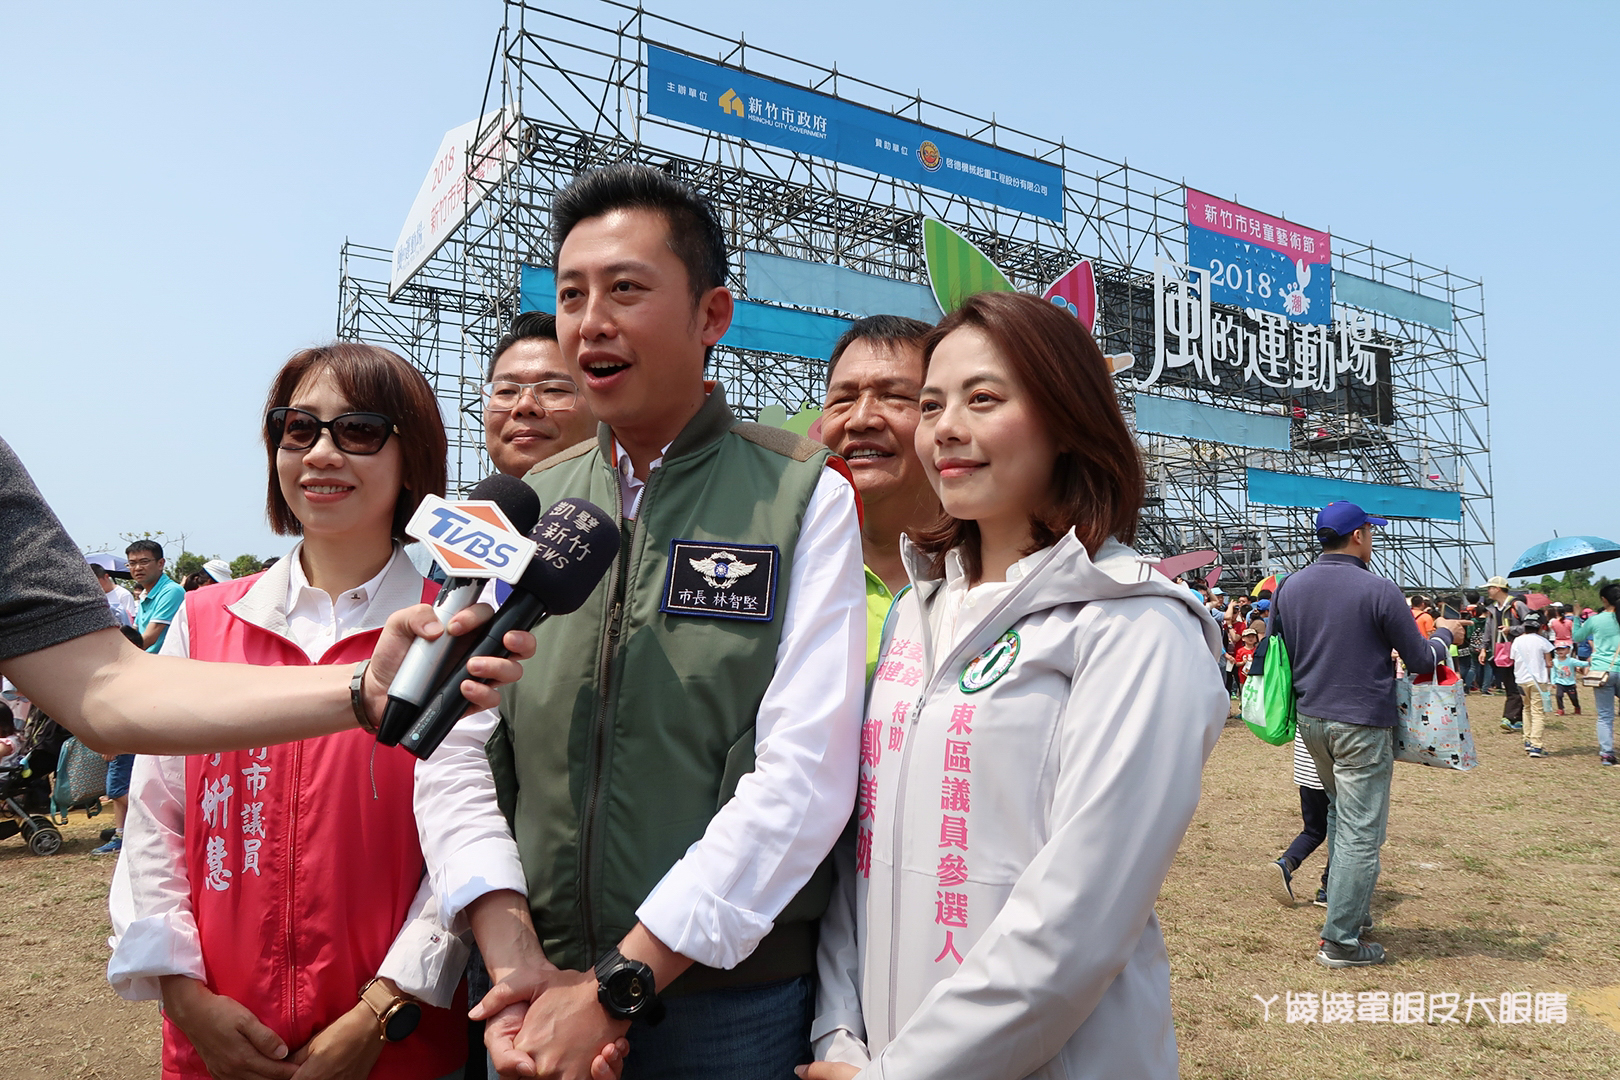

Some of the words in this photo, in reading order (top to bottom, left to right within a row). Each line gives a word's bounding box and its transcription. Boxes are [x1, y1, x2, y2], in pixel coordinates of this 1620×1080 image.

[666, 81, 708, 102] 主辦單位
[747, 114, 774, 127] HSINCHU
[774, 120, 788, 130] CITY
[788, 124, 828, 139] GOVERNMENT
[748, 96, 828, 133] 新竹市政府
[432, 145, 455, 193] 2018
[1204, 203, 1316, 255] 新竹市兒童藝術節
[1209, 258, 1273, 299] 2018
[1133, 256, 1397, 394] 風的運動場
[427, 506, 519, 569] TVBS
[549, 501, 600, 534] 凱擘
[534, 542, 570, 570] EWS
[678, 588, 706, 605] 市長
[713, 591, 757, 611] 林智堅
[888, 700, 912, 753] 特助
[240, 746, 272, 877] 市議員
[934, 702, 977, 966] 東區議員參選人
